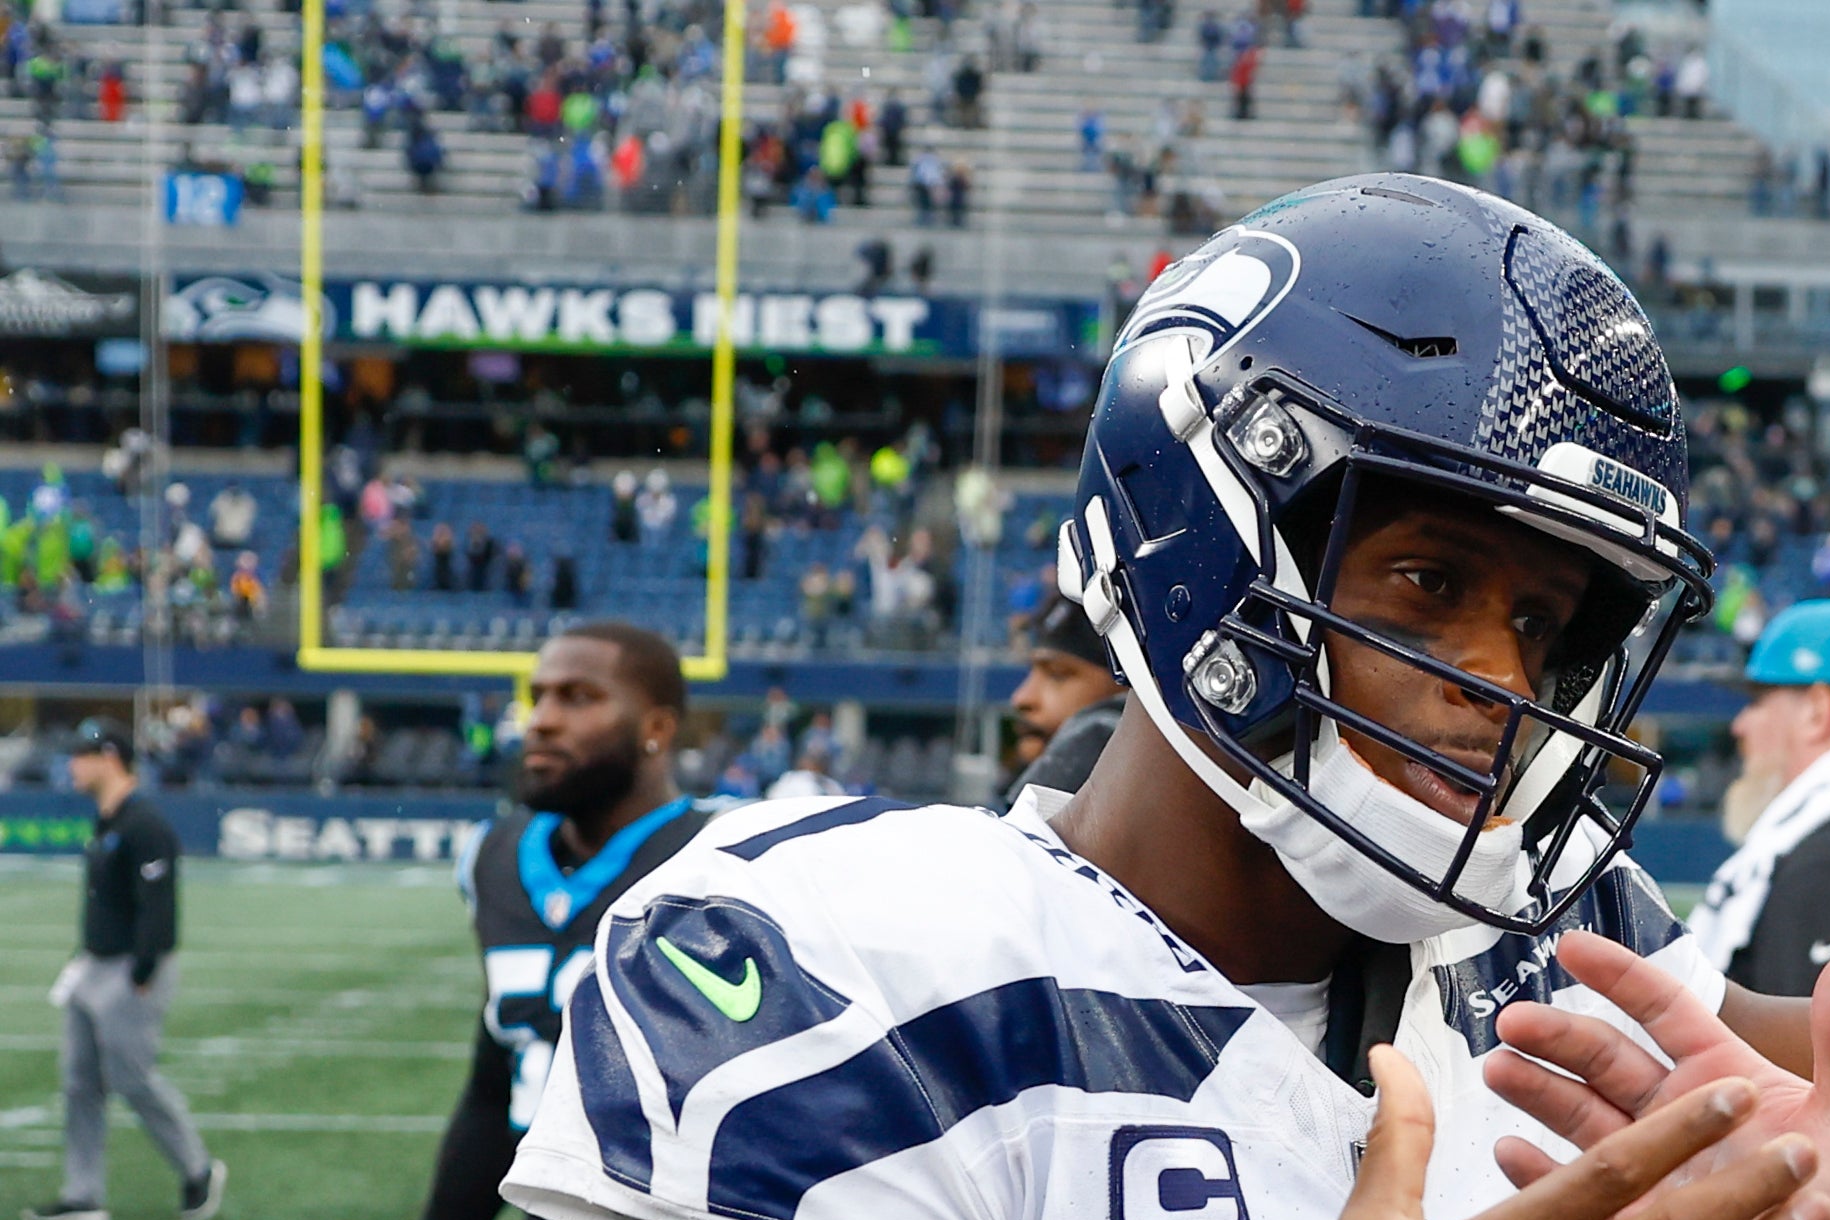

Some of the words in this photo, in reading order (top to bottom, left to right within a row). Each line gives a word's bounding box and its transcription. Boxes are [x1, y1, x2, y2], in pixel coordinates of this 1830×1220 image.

[351, 282, 675, 347] HAWKS
[693, 294, 929, 351] NEST
[1592, 459, 1667, 516] SEAHAWKS
